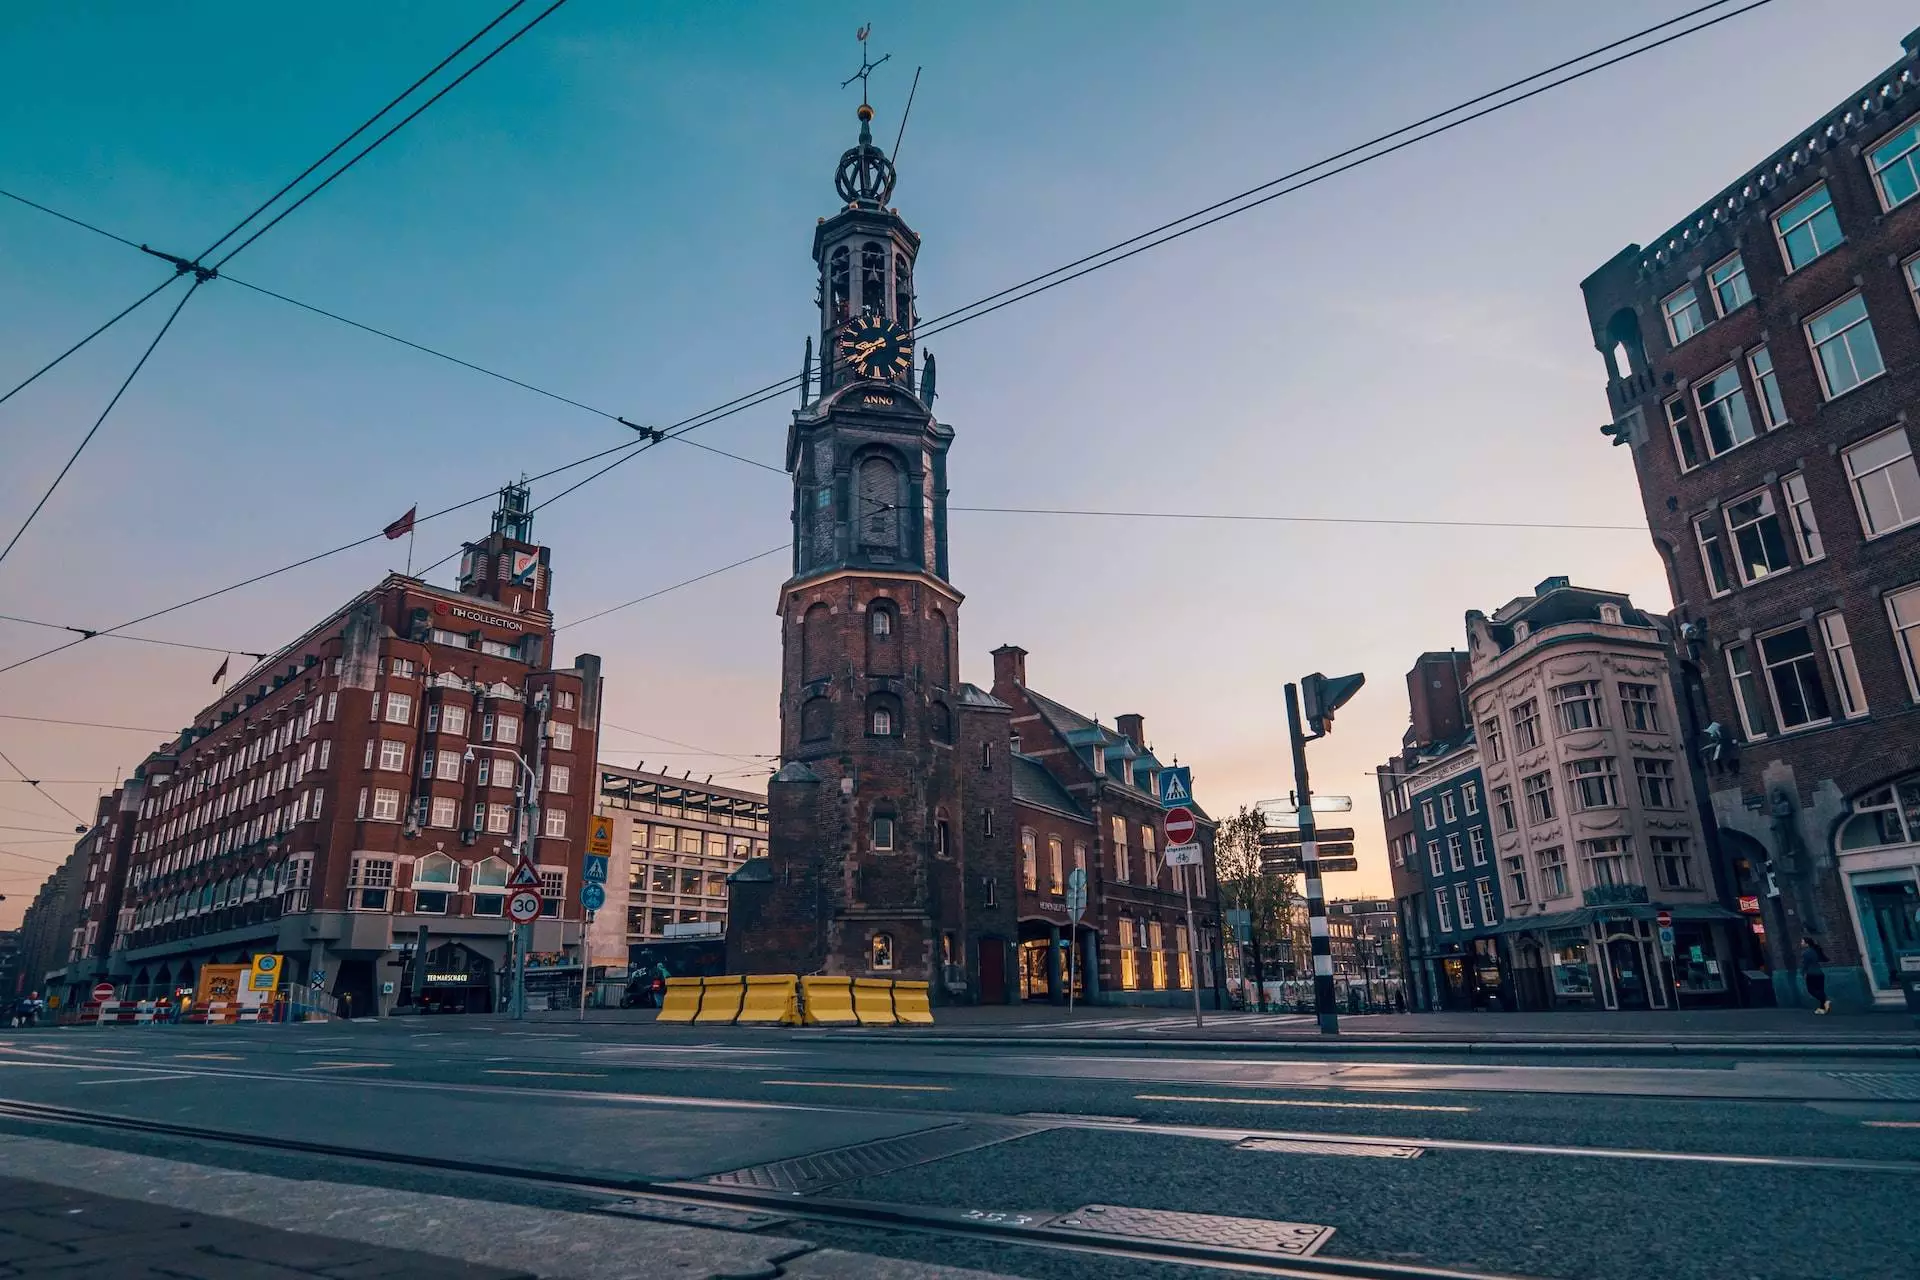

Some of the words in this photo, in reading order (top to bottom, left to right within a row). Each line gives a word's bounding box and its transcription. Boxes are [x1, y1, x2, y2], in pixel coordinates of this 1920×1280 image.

[863, 395, 893, 406] ANNO
[467, 611, 523, 631] COLLECTION
[513, 899, 536, 913] 30
